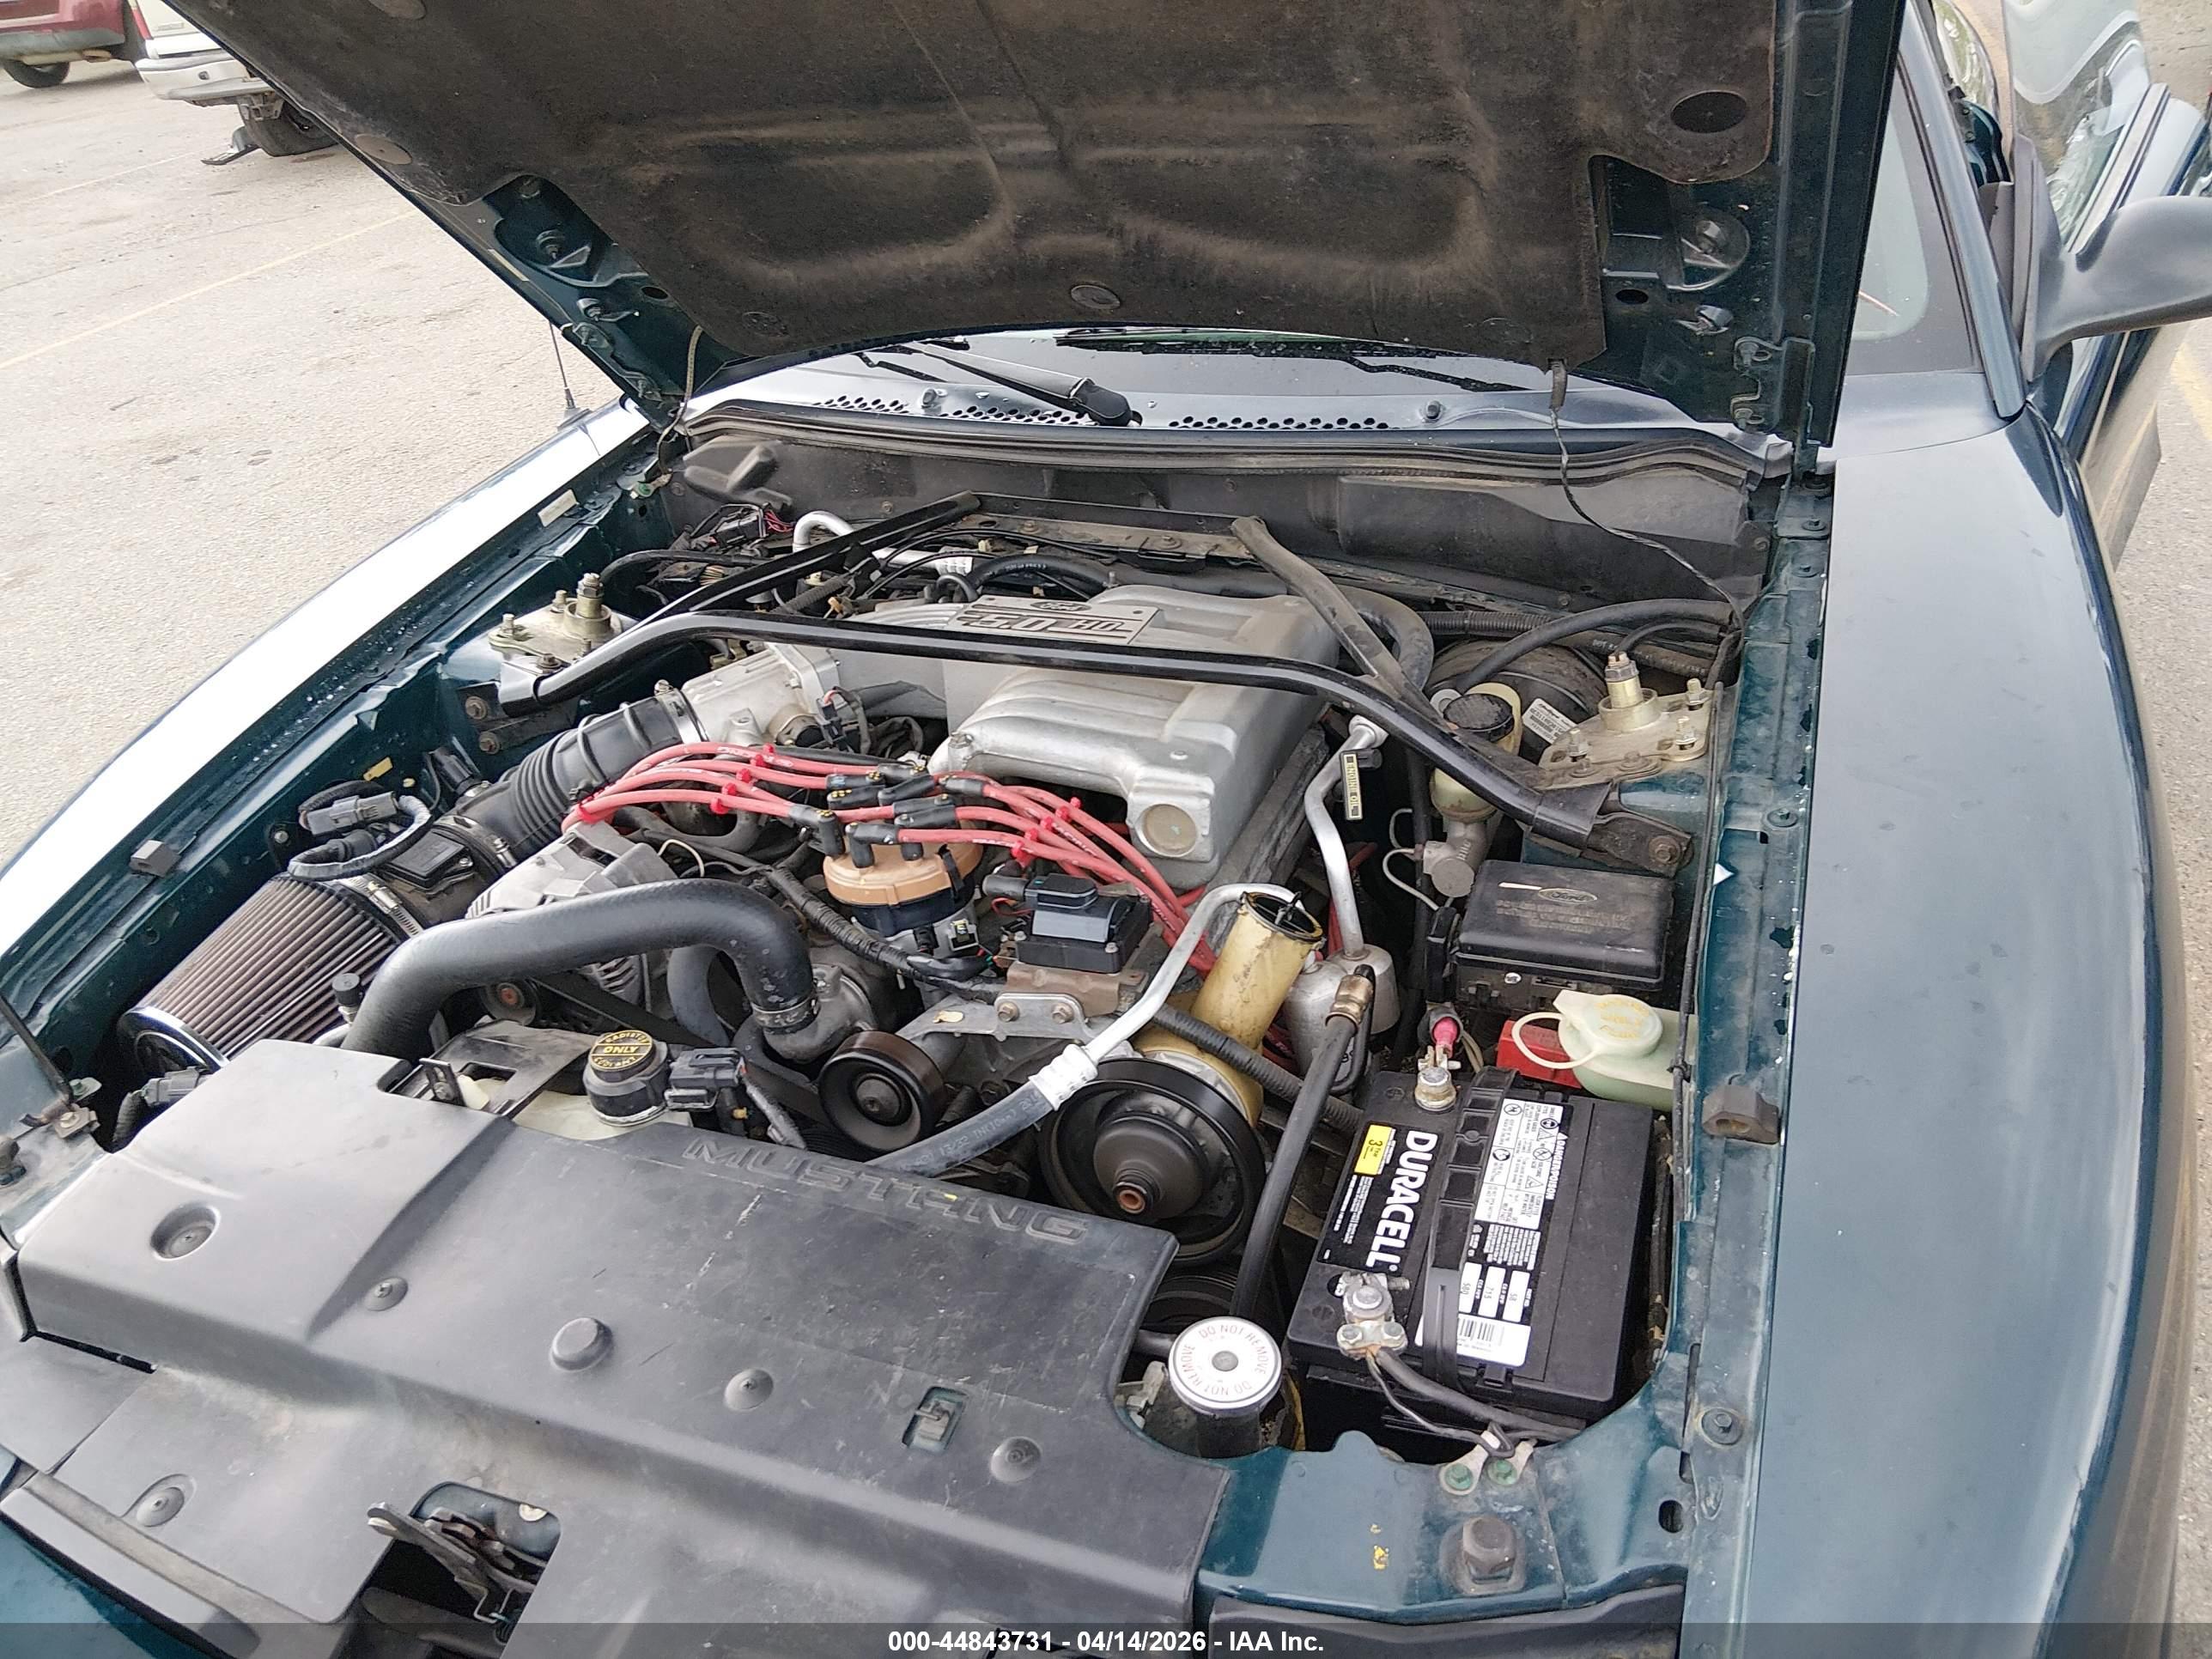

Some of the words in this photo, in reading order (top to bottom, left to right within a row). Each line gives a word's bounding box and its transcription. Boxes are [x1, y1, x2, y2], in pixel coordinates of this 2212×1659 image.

[970, 615, 1058, 631] 5.0
[1068, 619, 1124, 631] HO
[593, 1056, 637, 1068] COOLANT
[683, 1135, 1090, 1246] MUSTANG
[1199, 1325, 1216, 1338] DO
[1220, 1324, 1244, 1335] NOT
[1245, 1333, 1270, 1375] REMOVE
[1181, 1345, 1203, 1388] REMOVE
[1204, 1386, 1229, 1395] NOT
[1235, 1381, 1253, 1394] DO
